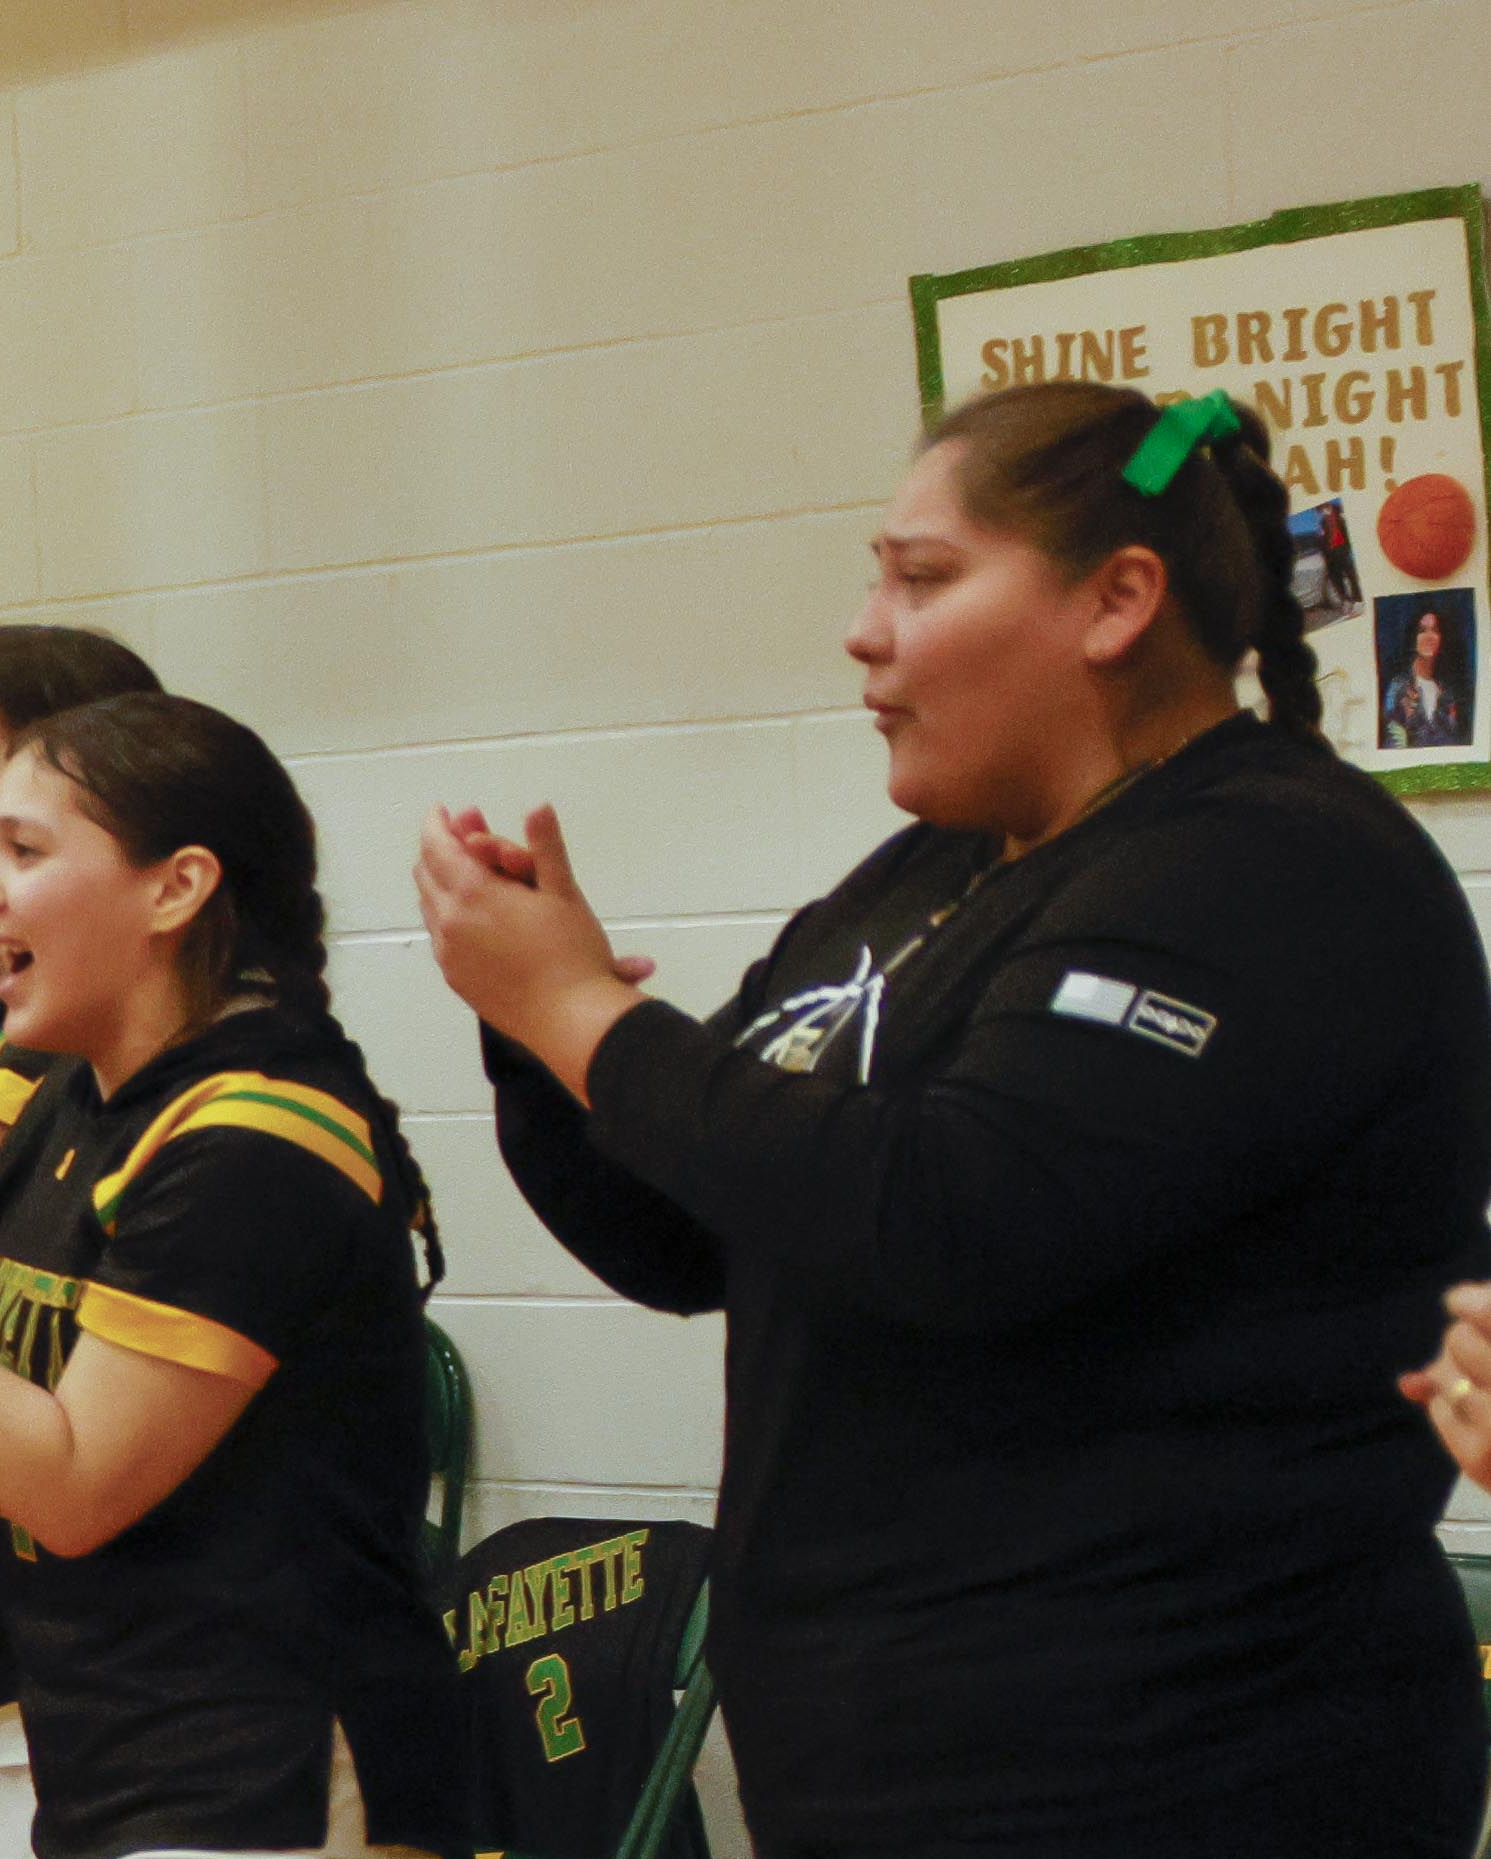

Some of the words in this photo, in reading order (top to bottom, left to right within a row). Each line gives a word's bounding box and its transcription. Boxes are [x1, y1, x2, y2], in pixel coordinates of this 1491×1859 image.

[981, 324, 1149, 391] SHINE
[1190, 289, 1436, 369] BRIGHT
[525, 1653, 587, 1763] 2
